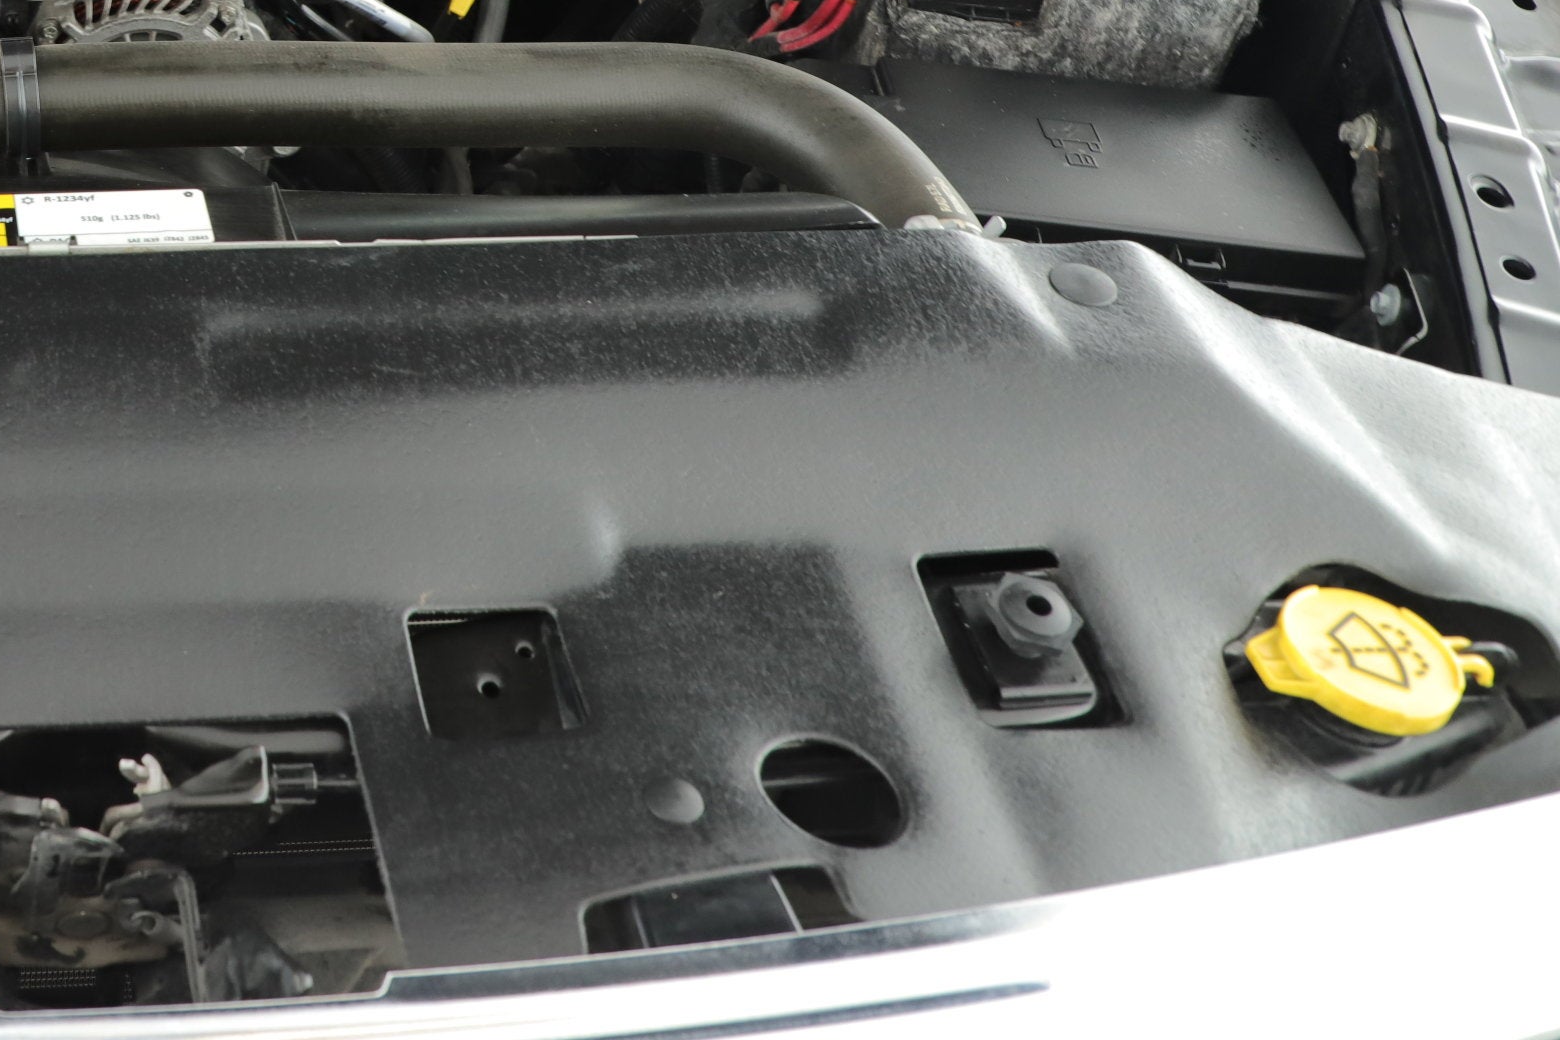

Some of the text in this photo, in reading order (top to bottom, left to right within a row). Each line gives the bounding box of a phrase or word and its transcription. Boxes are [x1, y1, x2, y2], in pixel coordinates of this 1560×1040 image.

[43, 195, 95, 203] R-1234yf
[80, 213, 160, 223] 510g (1.125 lbs)
